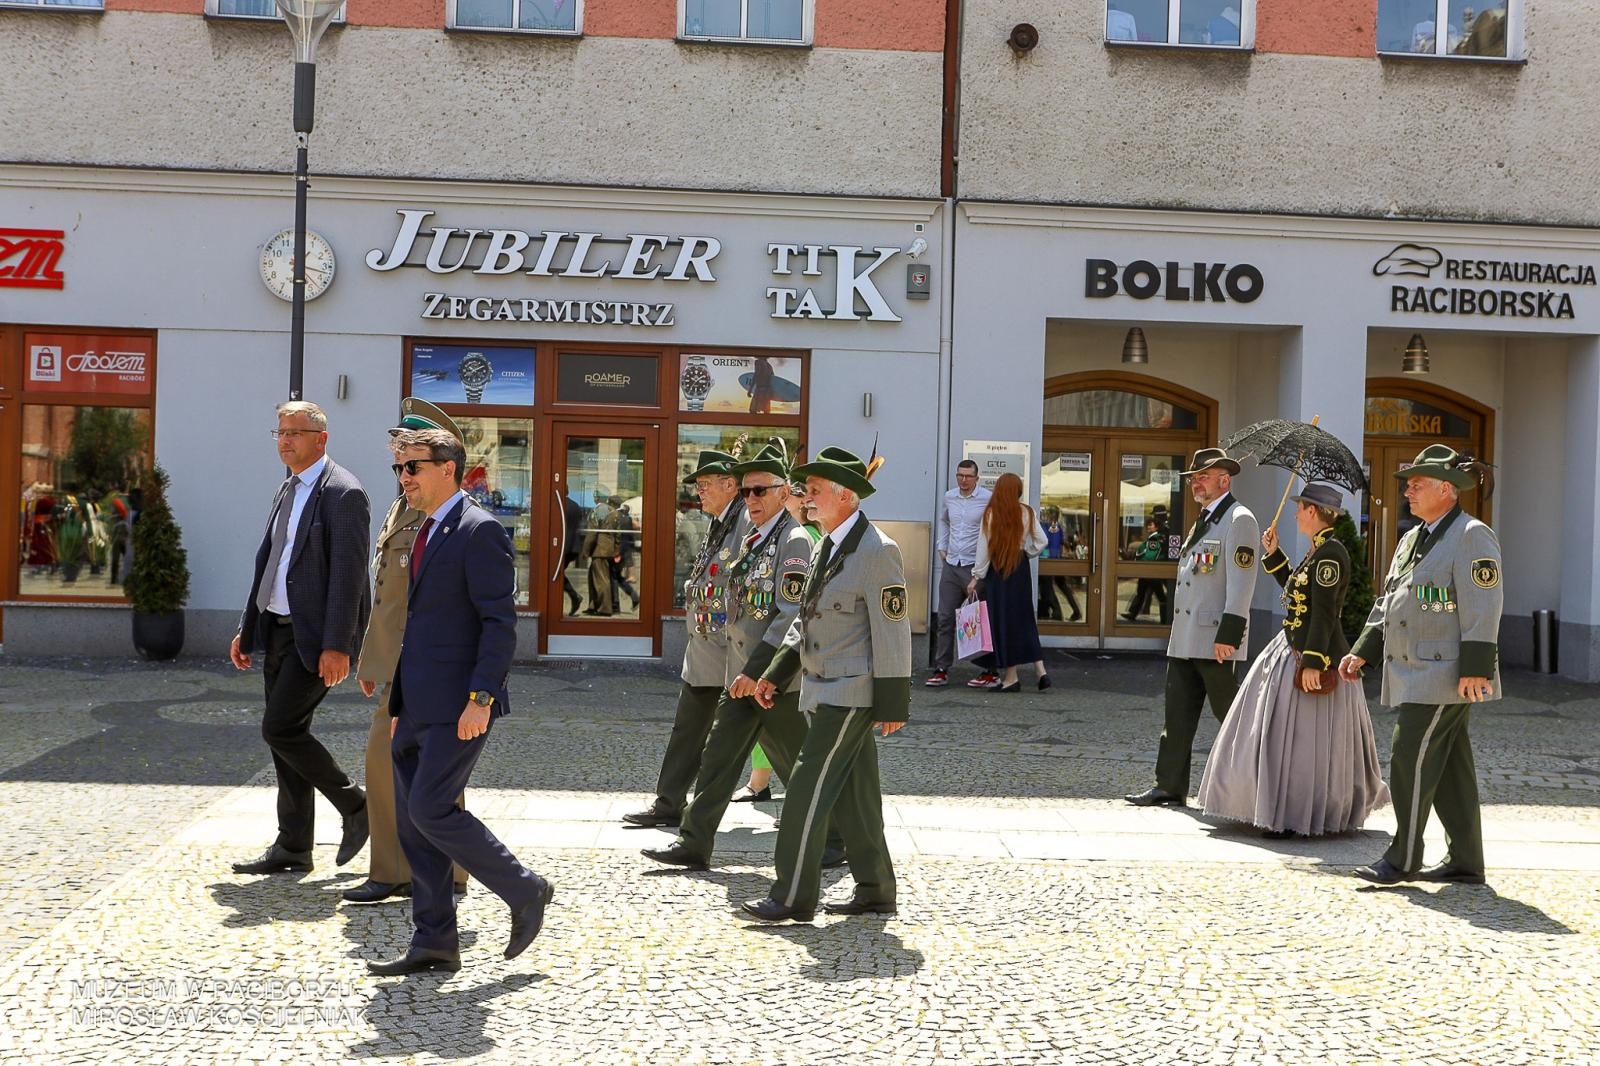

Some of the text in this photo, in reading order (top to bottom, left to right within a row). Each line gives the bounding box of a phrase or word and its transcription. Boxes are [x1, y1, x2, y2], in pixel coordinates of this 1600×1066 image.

[365, 208, 722, 282] JUBILER
[1085, 258, 1264, 303] BOLKO
[1446, 259, 1597, 285] RESTAURACJA
[421, 292, 675, 326] ZEGARMISTRZ
[1391, 285, 1575, 319] RACIBORSKA
[584, 372, 630, 384] ROAMER
[712, 358, 750, 367] ORIENT
